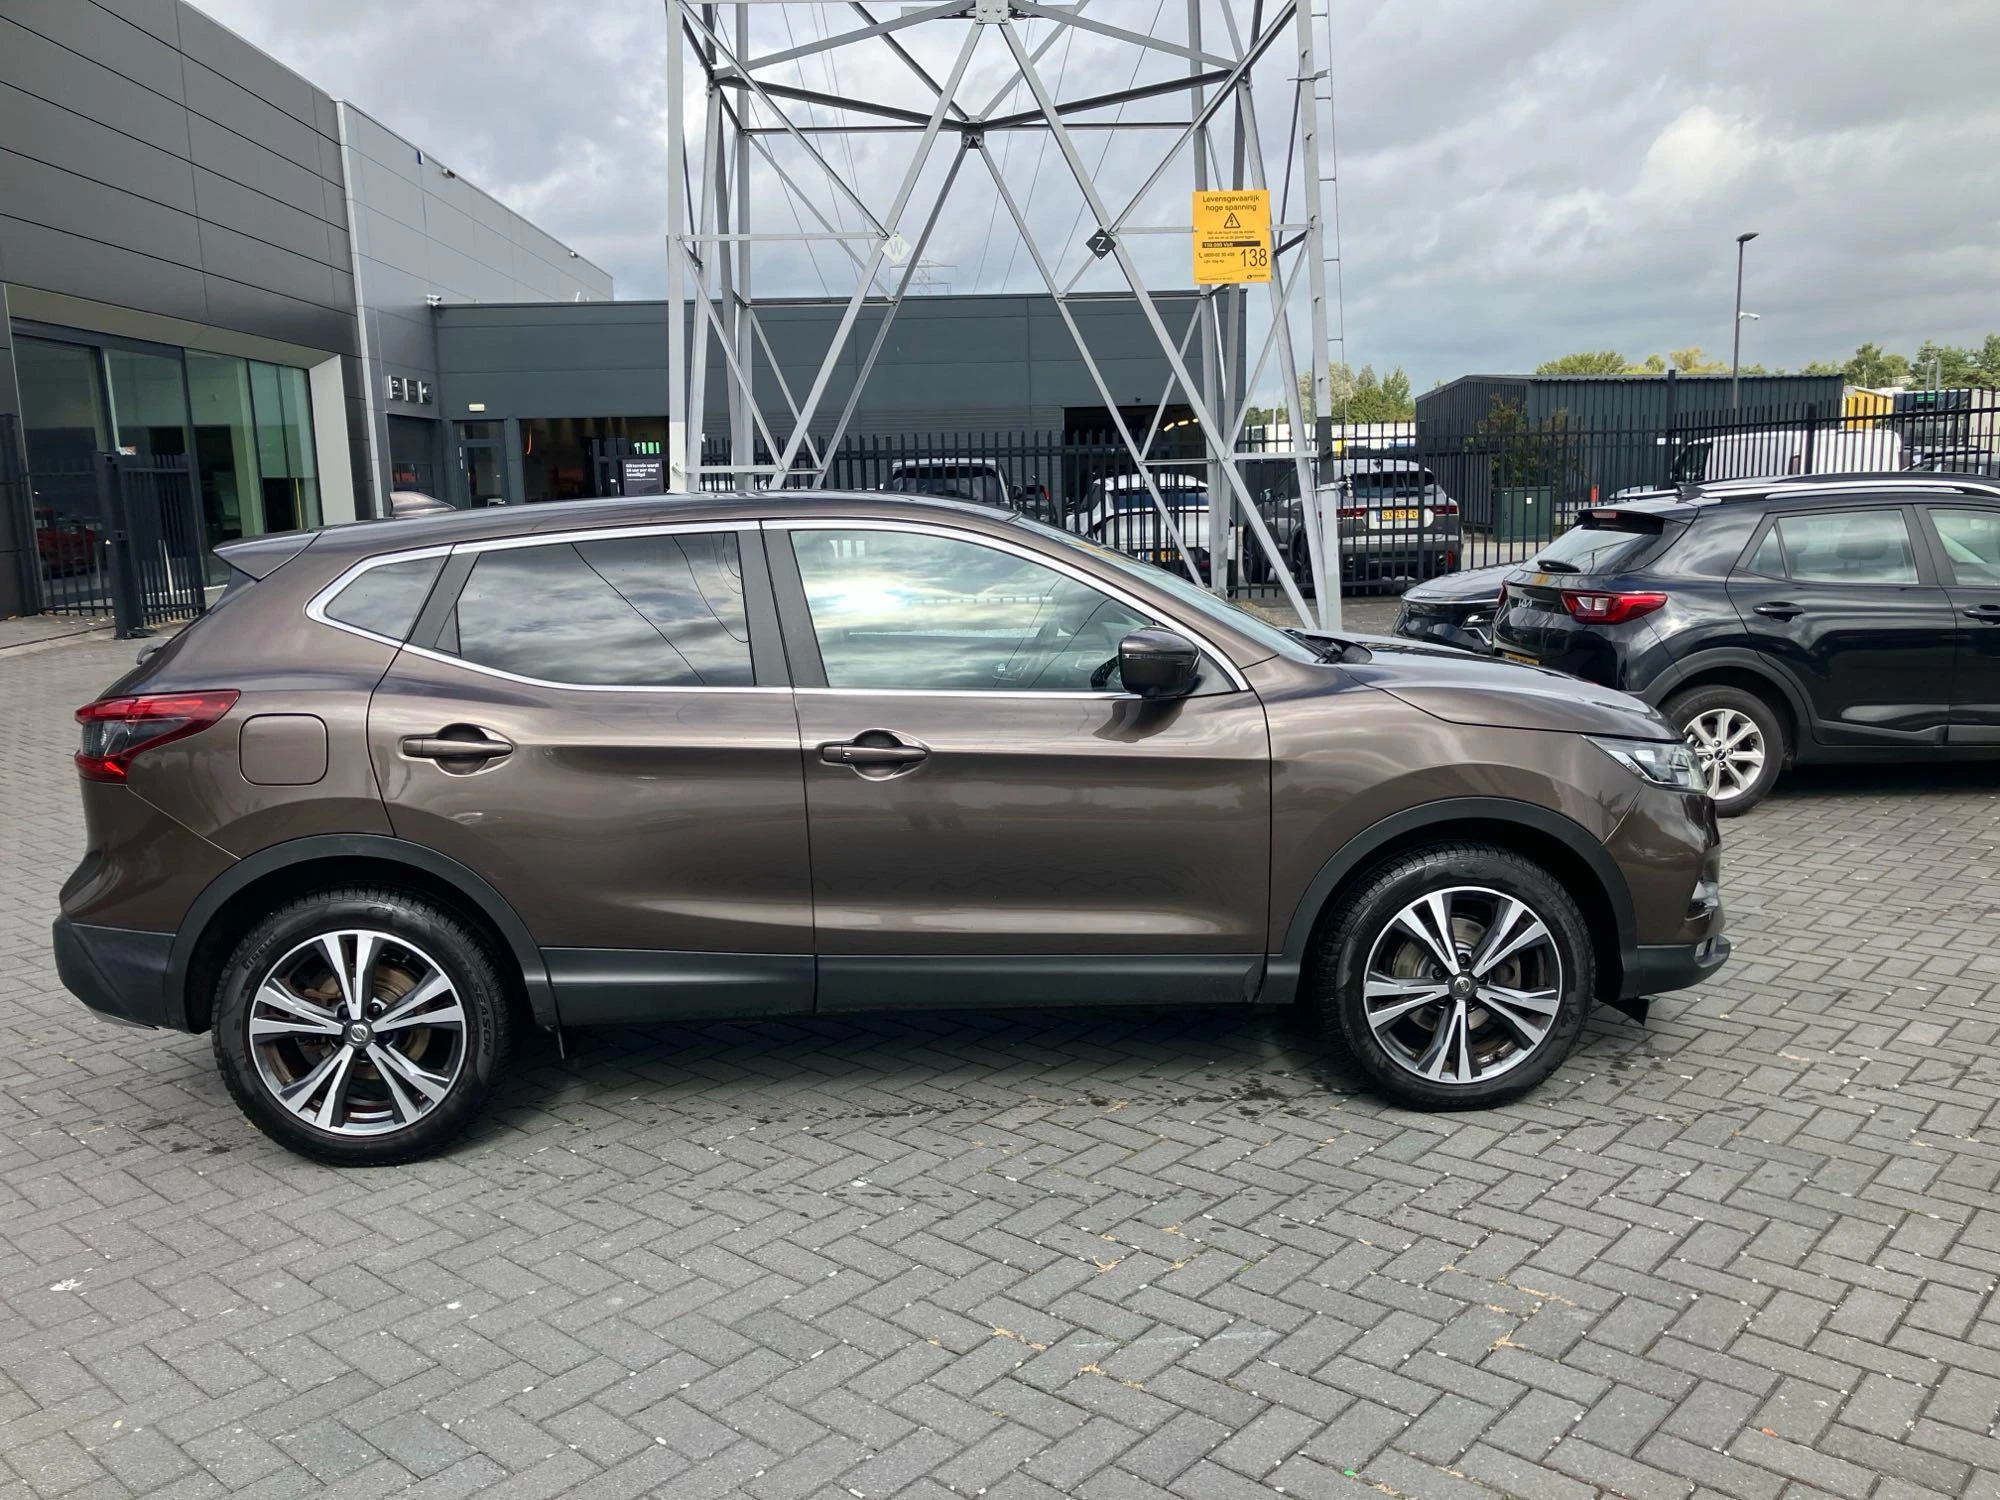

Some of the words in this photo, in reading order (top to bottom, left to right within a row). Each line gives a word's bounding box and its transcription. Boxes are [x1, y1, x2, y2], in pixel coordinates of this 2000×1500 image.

[1202, 195, 1260, 203] Levensgevaarlijk
[1205, 204, 1223, 212] hoge
[1224, 204, 1257, 212] spanning
[889, 241, 903, 256] W
[1095, 236, 1106, 252] Z
[1240, 248, 1268, 267] 138
